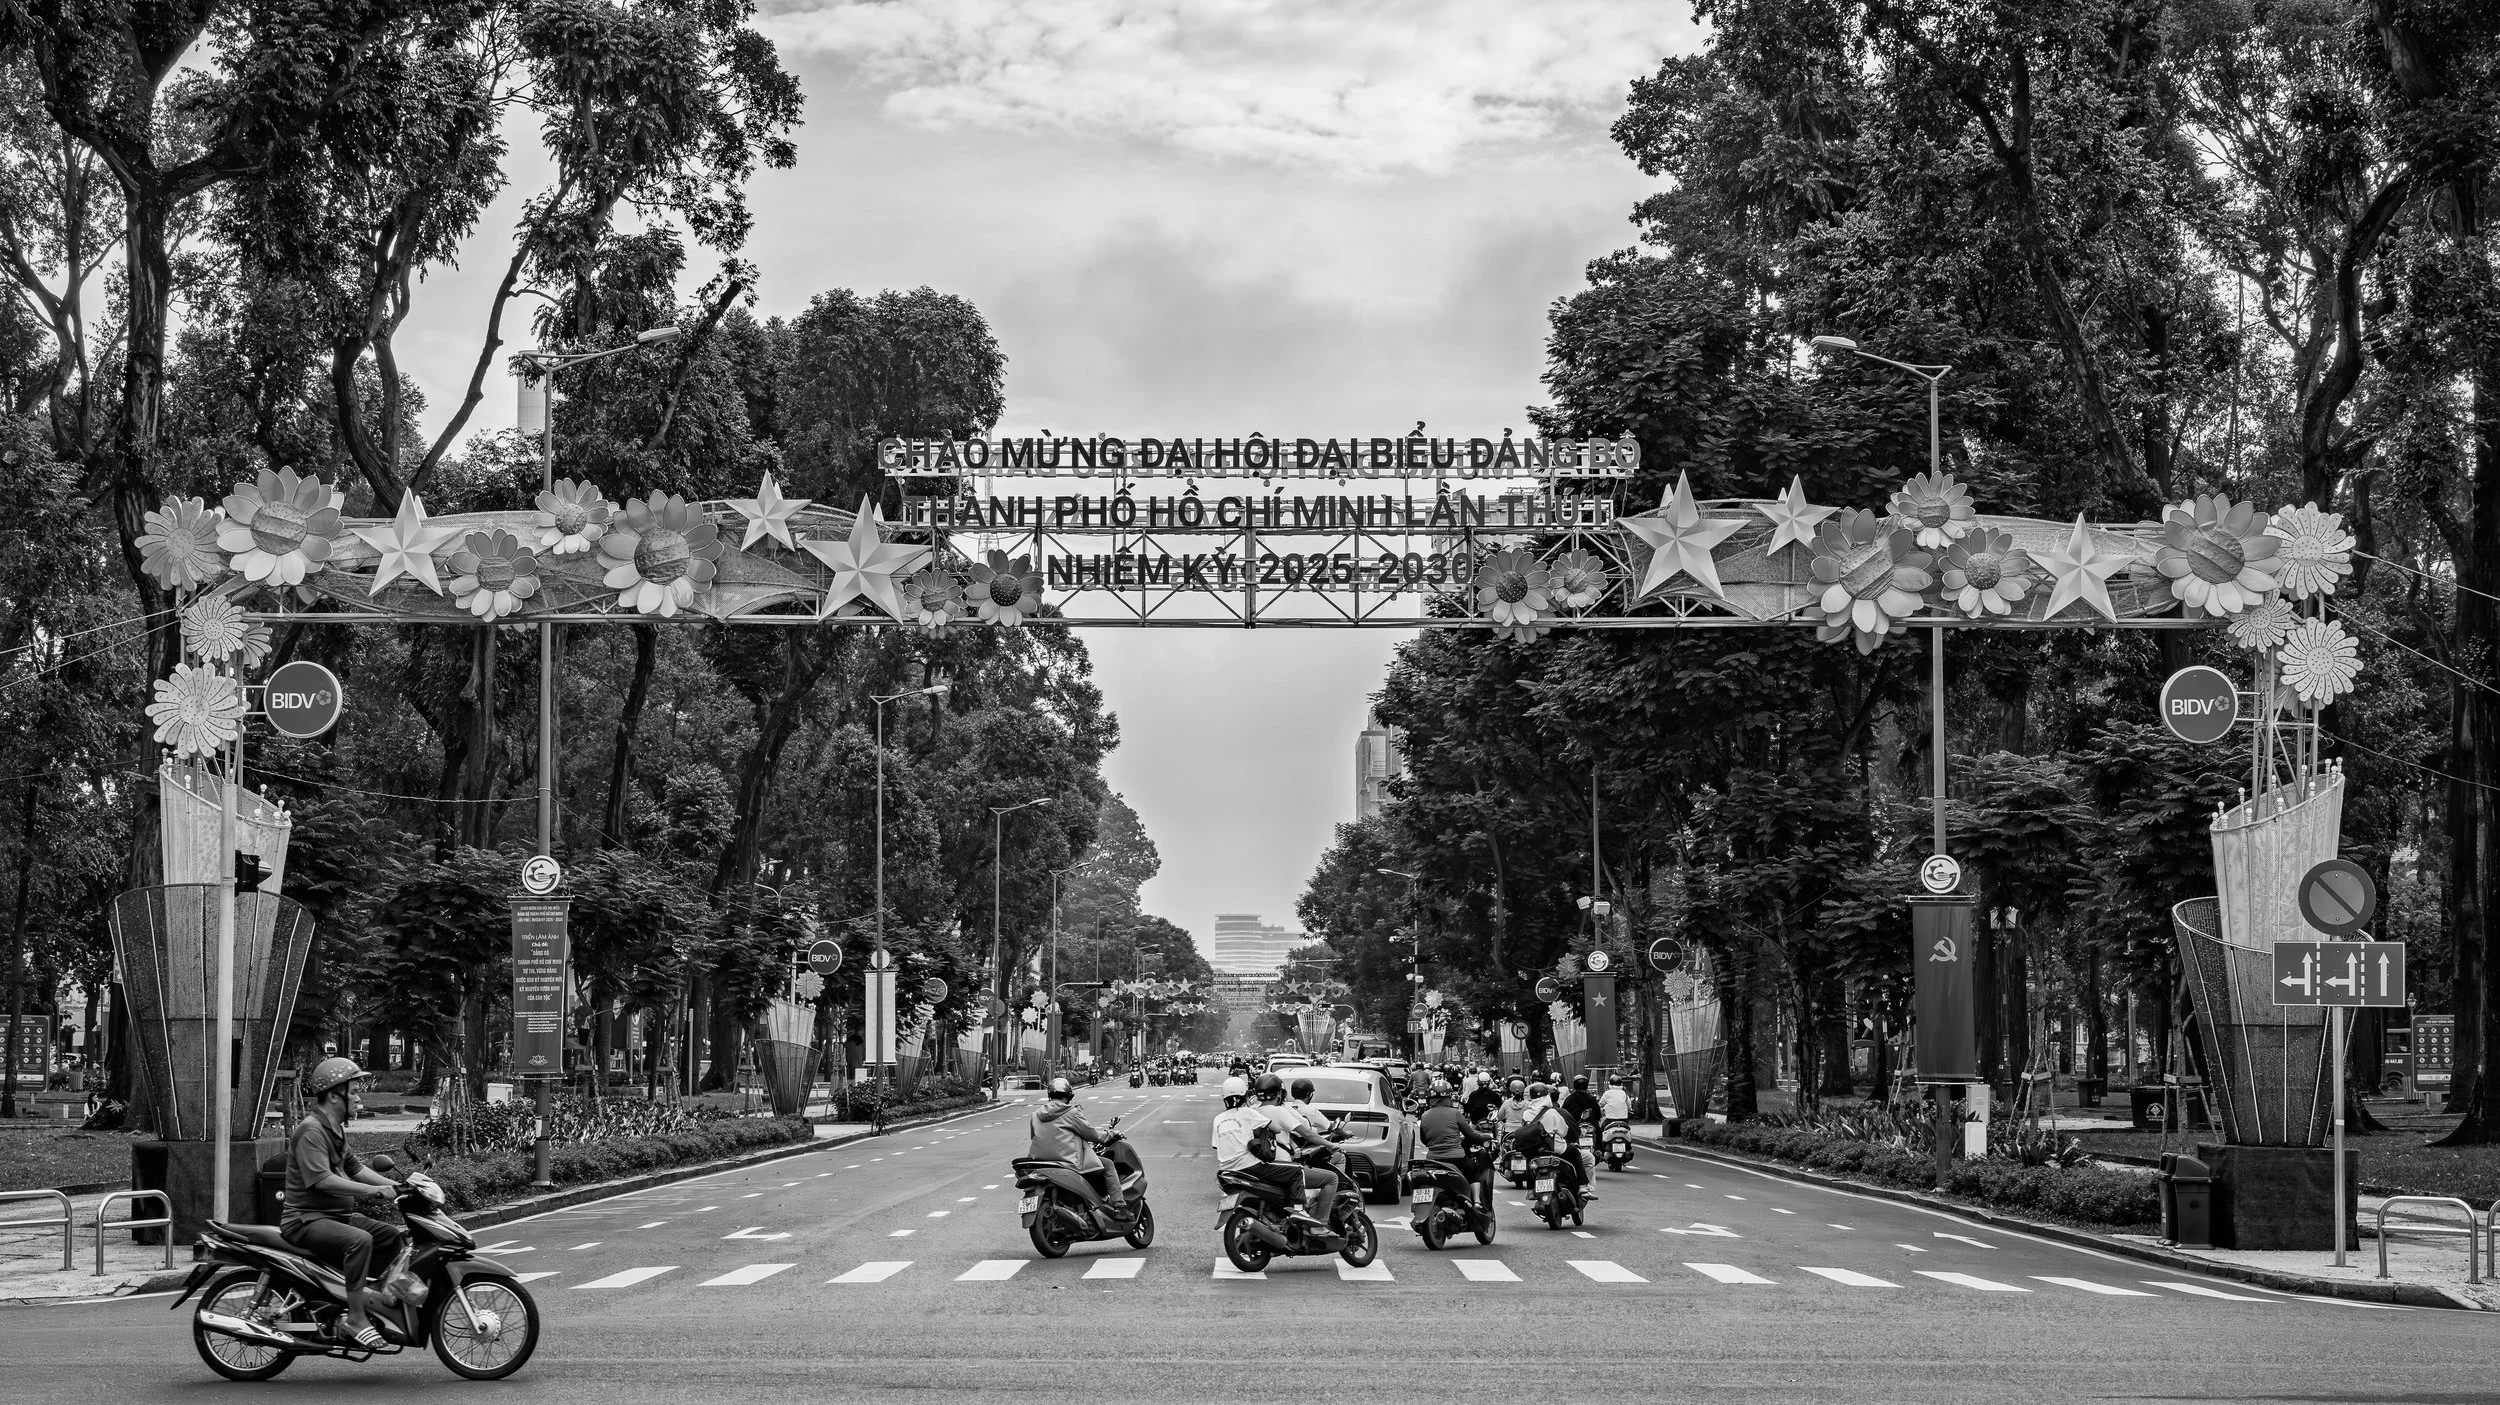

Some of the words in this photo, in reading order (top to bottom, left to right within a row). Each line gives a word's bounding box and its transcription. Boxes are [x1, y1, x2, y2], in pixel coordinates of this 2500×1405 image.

[878, 429, 989, 469] CHÀO
[1002, 429, 1128, 469] MỪNG
[1138, 438, 1203, 476] ĐẠI
[1216, 432, 1280, 477] HỘI
[1293, 438, 1358, 476] ĐẠI
[1372, 421, 1455, 469] BIỂU
[1468, 428, 1578, 469] ĐẢNG
[1589, 430, 1641, 477] BỘ
[903, 487, 1043, 527] THÀNH
[1055, 483, 1137, 527] PHỐ
[1150, 483, 1204, 527] HỒ
[1217, 487, 1281, 527] CHÍ
[1294, 495, 1393, 527] MINH
[1405, 482, 1486, 527] LẦN
[1499, 487, 1586, 527] THỨ
[1048, 546, 1171, 592] NHIỆM
[1184, 546, 1237, 585] KỲ
[271, 692, 317, 709] BIDV
[2171, 698, 2216, 715] BIDV
[811, 954, 832, 963] BIDV
[1653, 951, 1674, 960] BIDV
